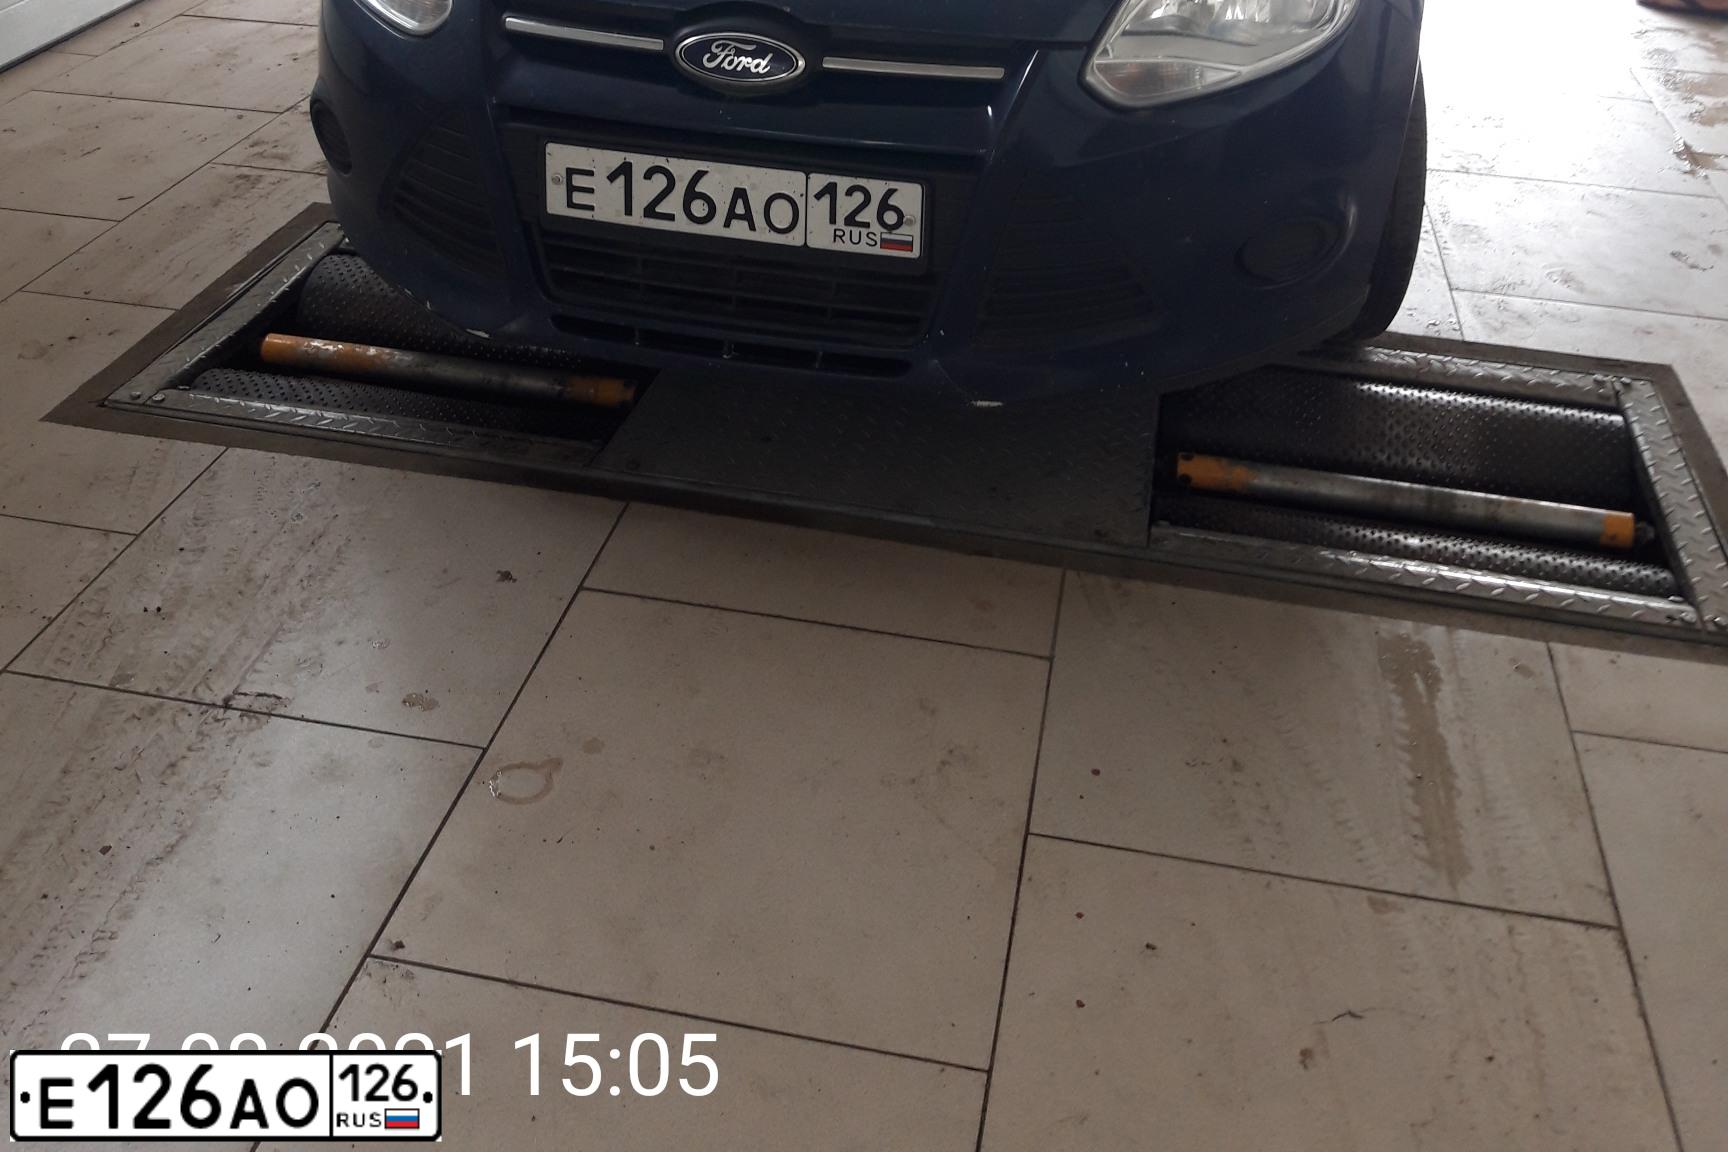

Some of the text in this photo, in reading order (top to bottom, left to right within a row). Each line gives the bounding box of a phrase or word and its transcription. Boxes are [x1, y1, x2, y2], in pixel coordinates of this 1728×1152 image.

[702, 38, 771, 75] Ford
[813, 181, 905, 232] 126
[833, 228, 878, 247] RUS
